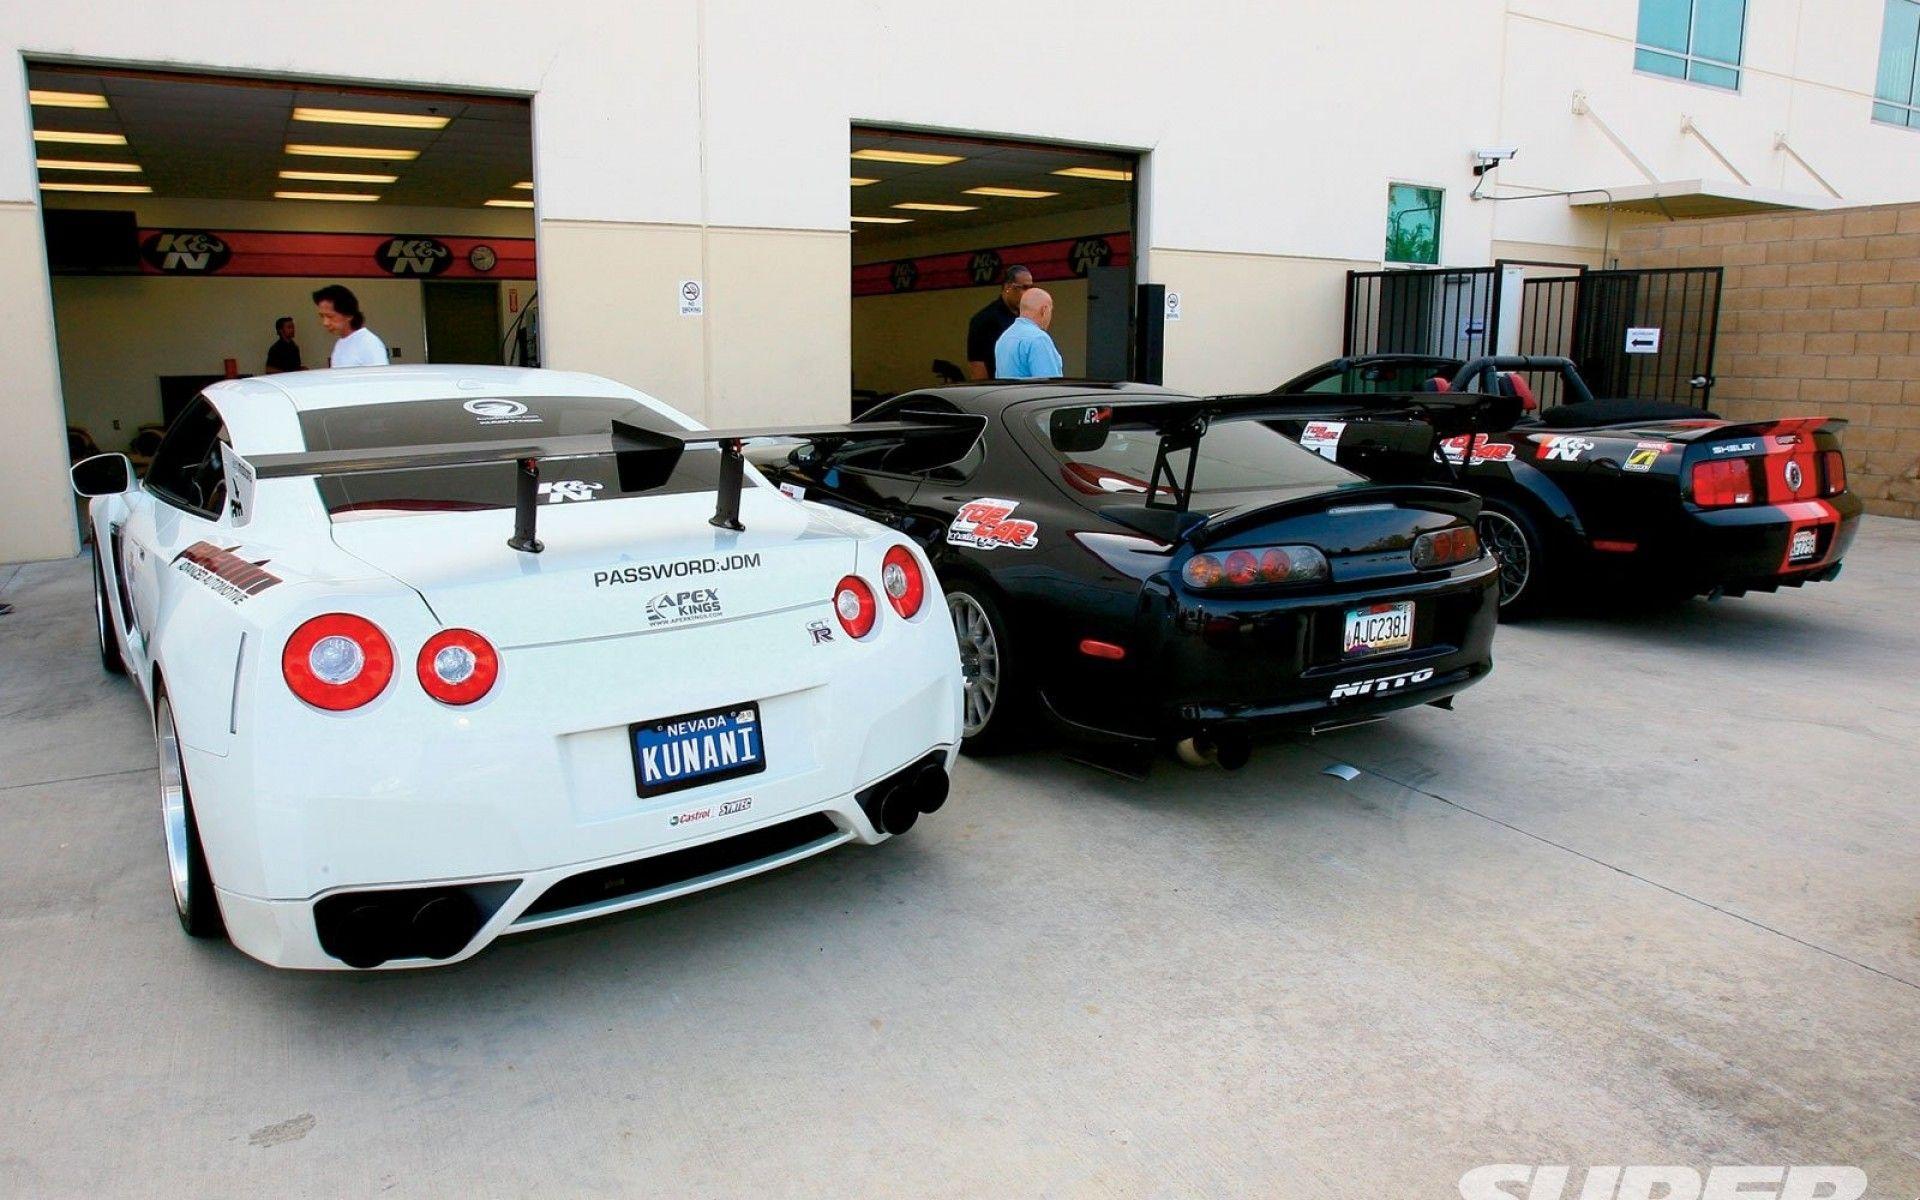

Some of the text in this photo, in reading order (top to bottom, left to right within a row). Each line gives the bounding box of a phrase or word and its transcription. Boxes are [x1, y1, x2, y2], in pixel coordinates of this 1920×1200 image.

[156, 233, 224, 270] K&N
[387, 240, 448, 273] K&N
[1545, 436, 1594, 461] K&N
[1712, 443, 1756, 454] SHELBY
[538, 480, 604, 503] K&N
[956, 504, 1012, 526] TOP
[973, 518, 1036, 546] CAR
[594, 553, 761, 587] PASSWORD:JDM
[658, 588, 719, 608] APEX
[679, 601, 721, 616] KINGS
[1353, 614, 1407, 643] AJC2381
[1330, 667, 1434, 699] NITTO
[667, 715, 727, 737] NEVADA
[642, 727, 756, 782] KUNANI
[679, 809, 711, 824] Castrol
